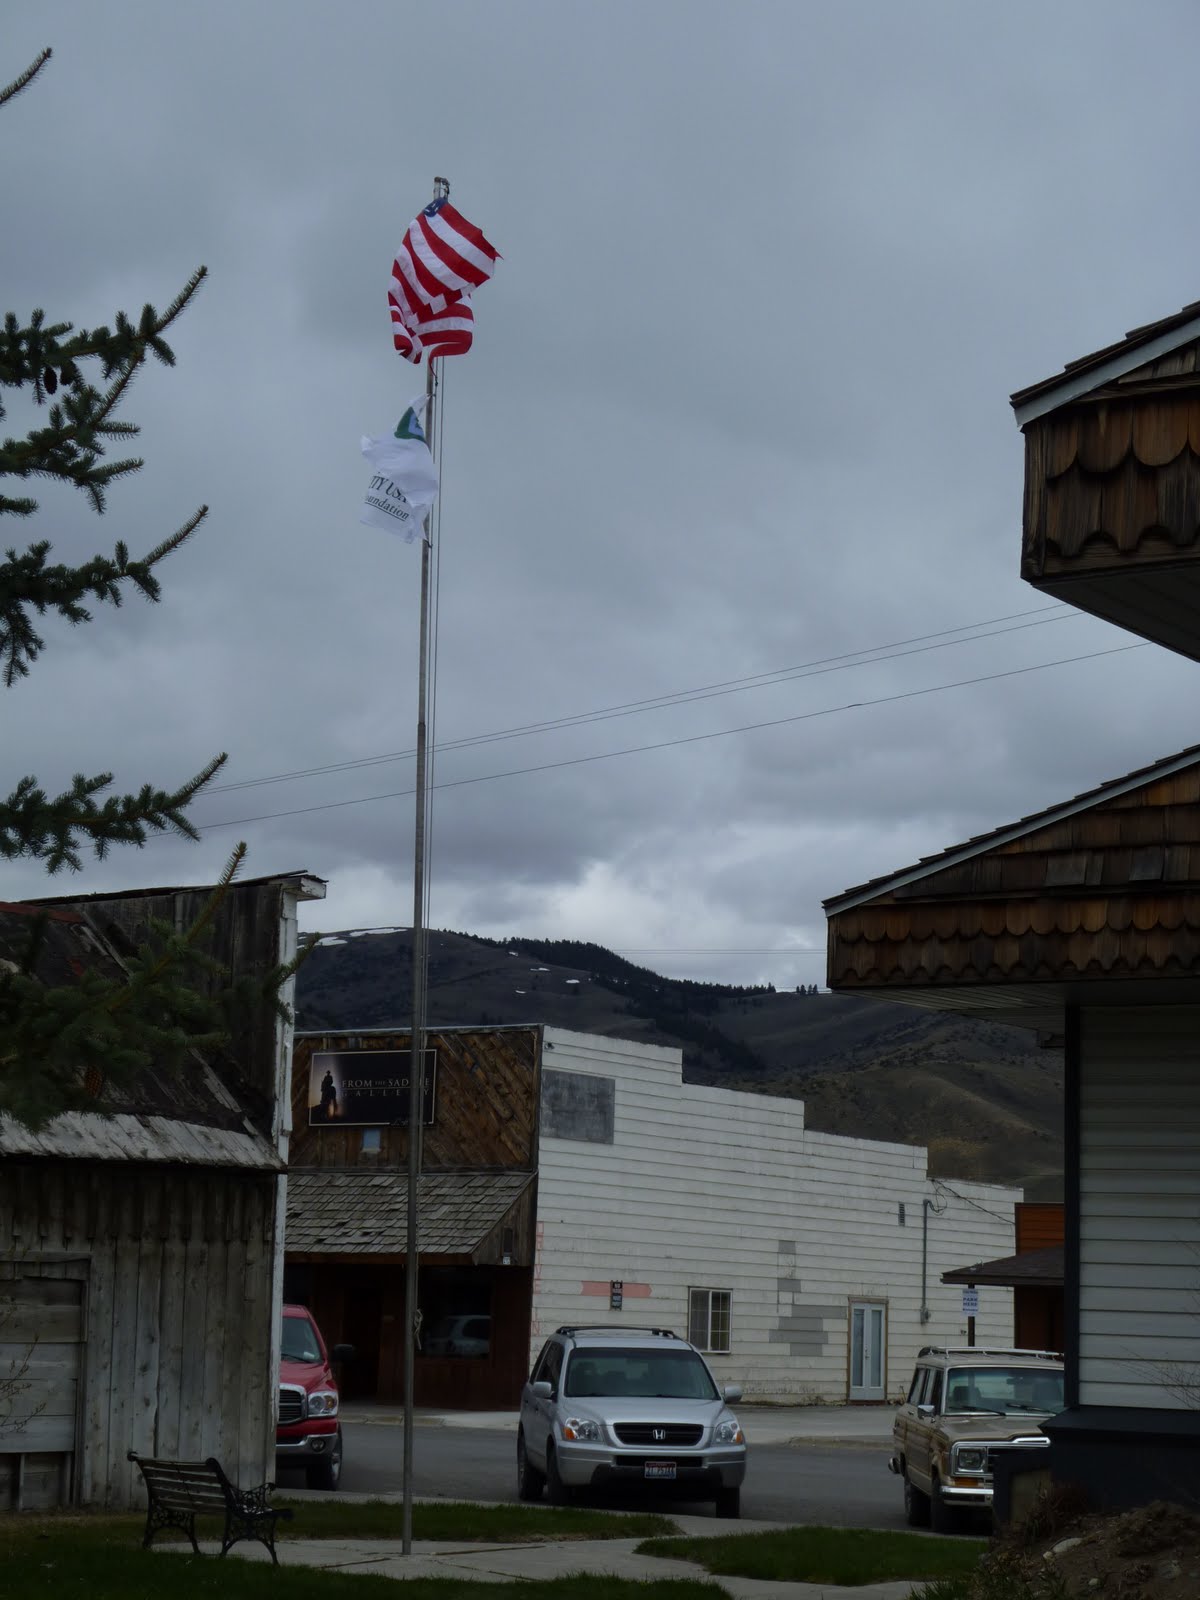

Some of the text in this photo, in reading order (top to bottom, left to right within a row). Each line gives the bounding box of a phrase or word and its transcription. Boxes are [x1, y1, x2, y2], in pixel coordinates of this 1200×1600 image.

[367, 495, 409, 520] undation
[342, 1079, 372, 1088] FROM
[388, 1078, 428, 1087] SADE
[343, 1089, 429, 1097] ALLEY
